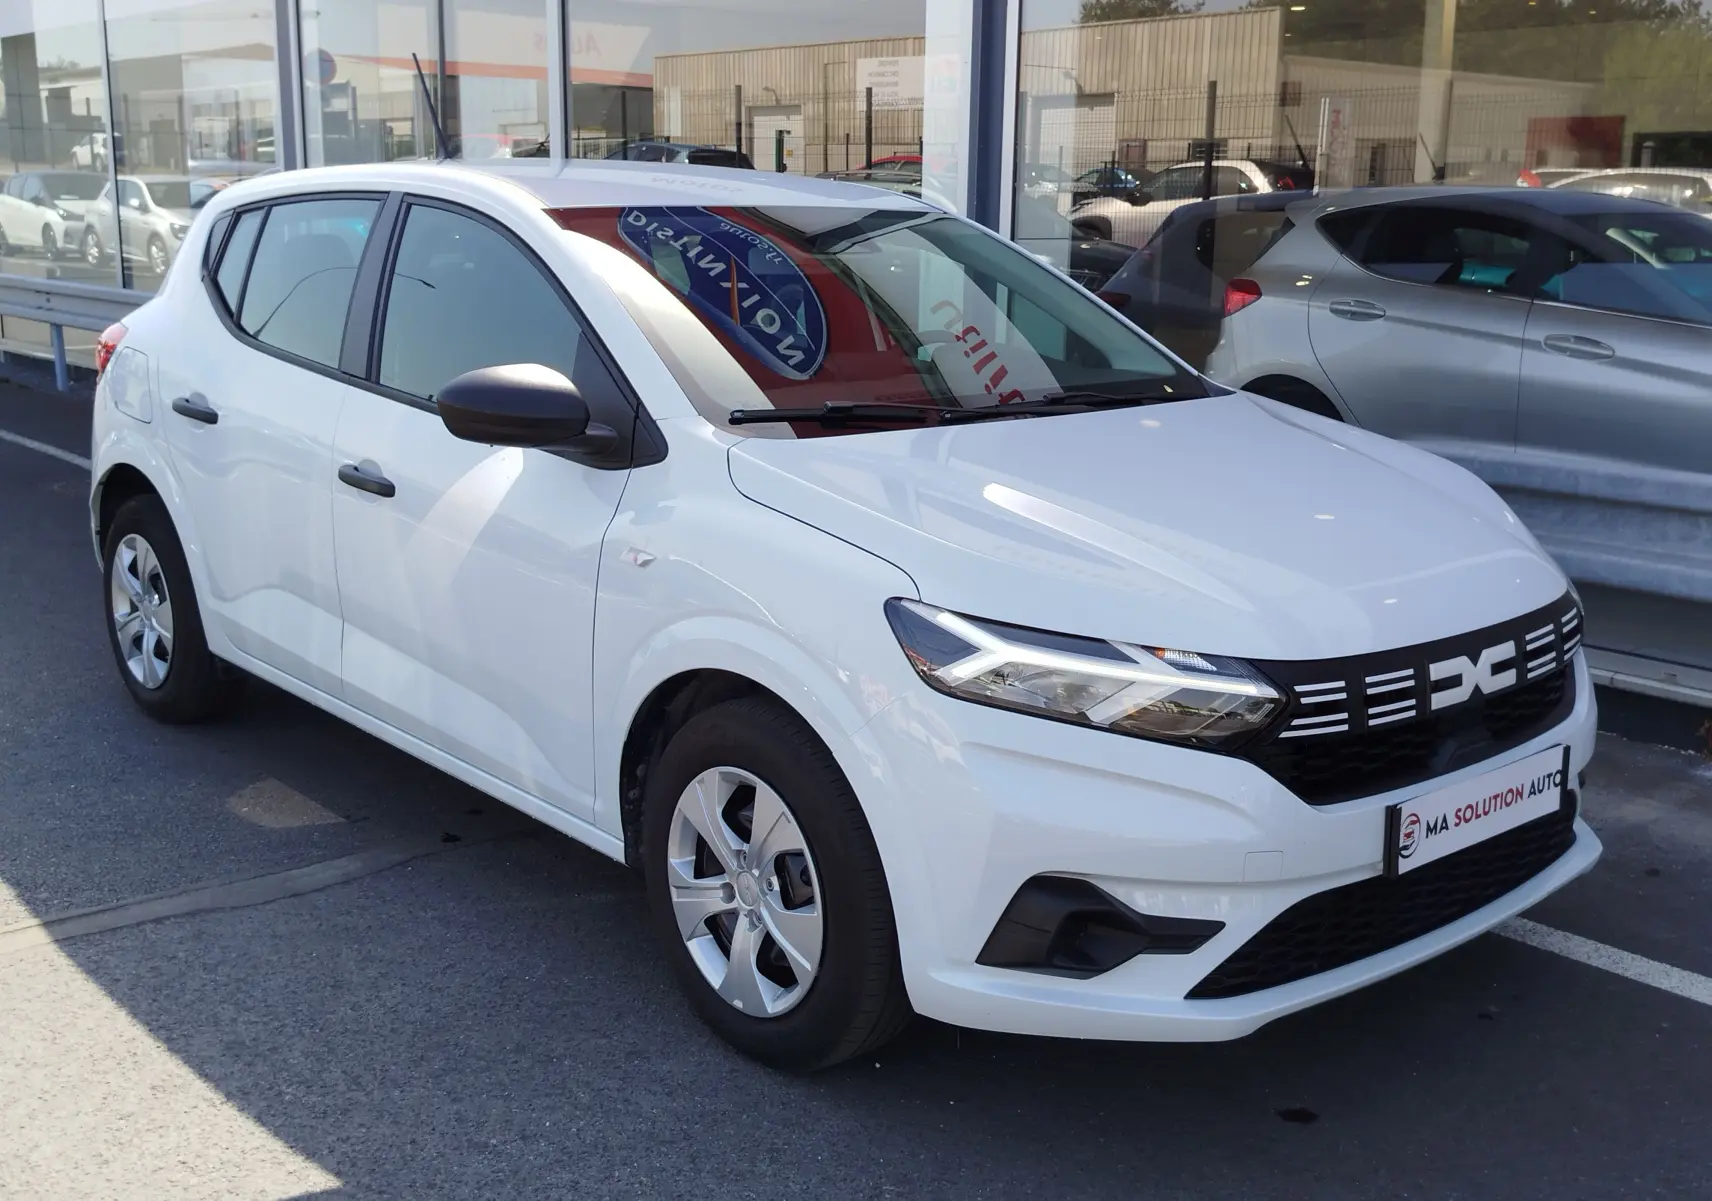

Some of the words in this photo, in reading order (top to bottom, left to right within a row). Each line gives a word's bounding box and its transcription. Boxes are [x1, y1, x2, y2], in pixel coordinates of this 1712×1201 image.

[1425, 813, 1449, 839] MA
[1454, 783, 1524, 827] SOLUTION
[1528, 769, 1562, 798] AUTO
